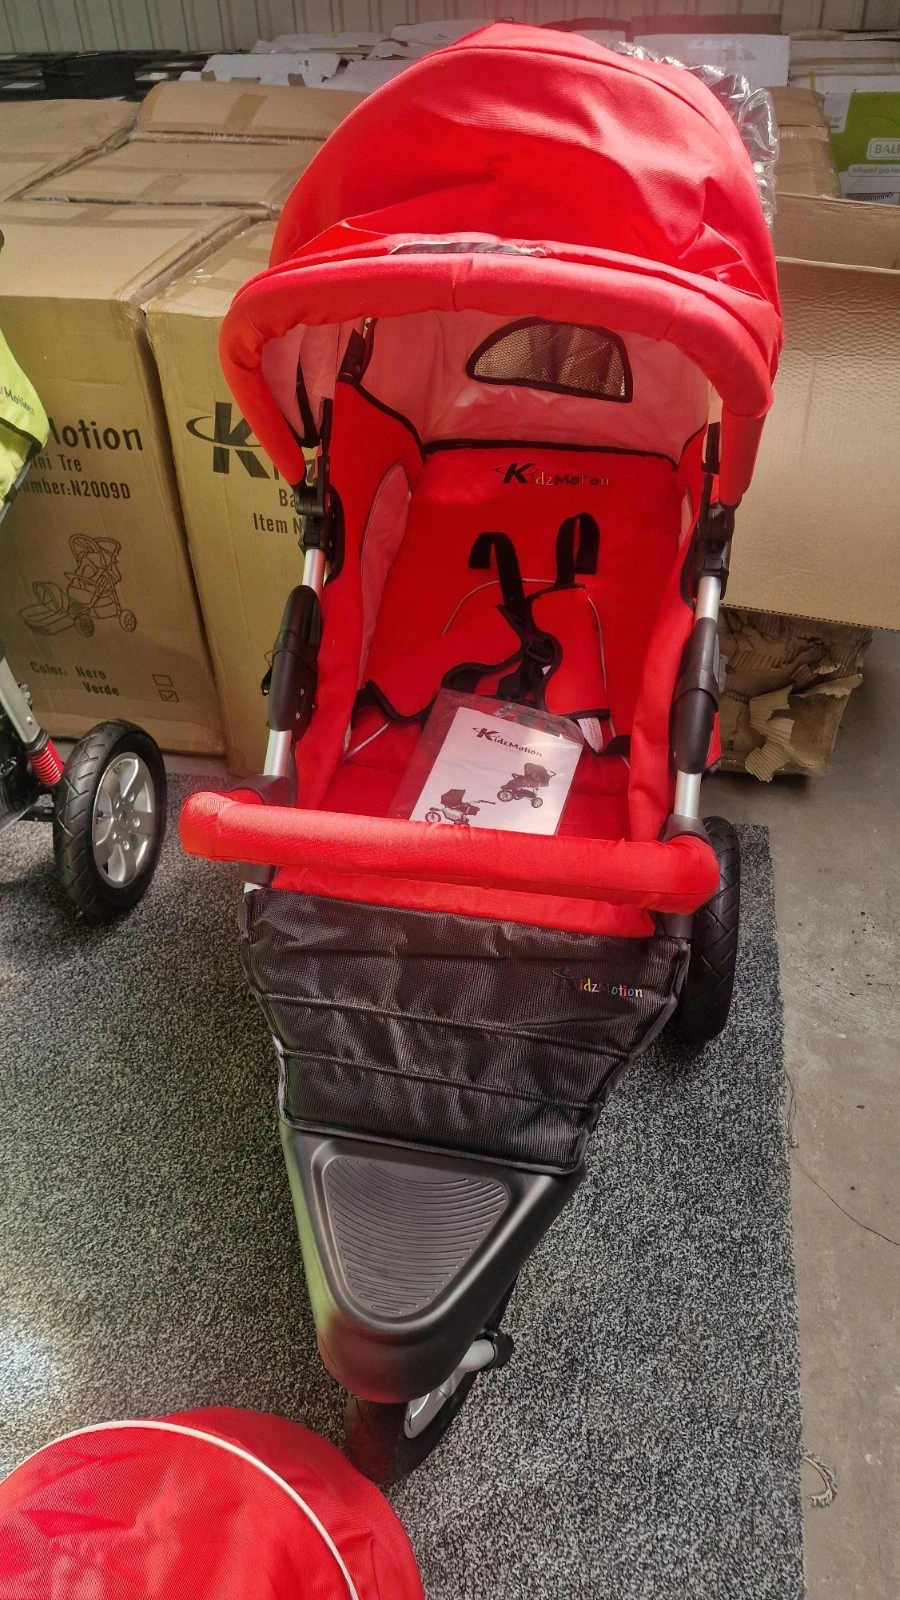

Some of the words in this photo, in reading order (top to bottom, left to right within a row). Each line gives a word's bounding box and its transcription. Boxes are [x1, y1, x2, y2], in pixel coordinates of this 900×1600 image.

[31, 453, 52, 470] ini
[58, 454, 82, 472] Tre
[20, 479, 131, 499] umber:N2009D
[253, 512, 288, 534] Item
[30, 661, 68, 677] Color:
[75, 666, 106, 680] Nero
[82, 682, 120, 697] Verde
[474, 727, 543, 758] KidzMotion
